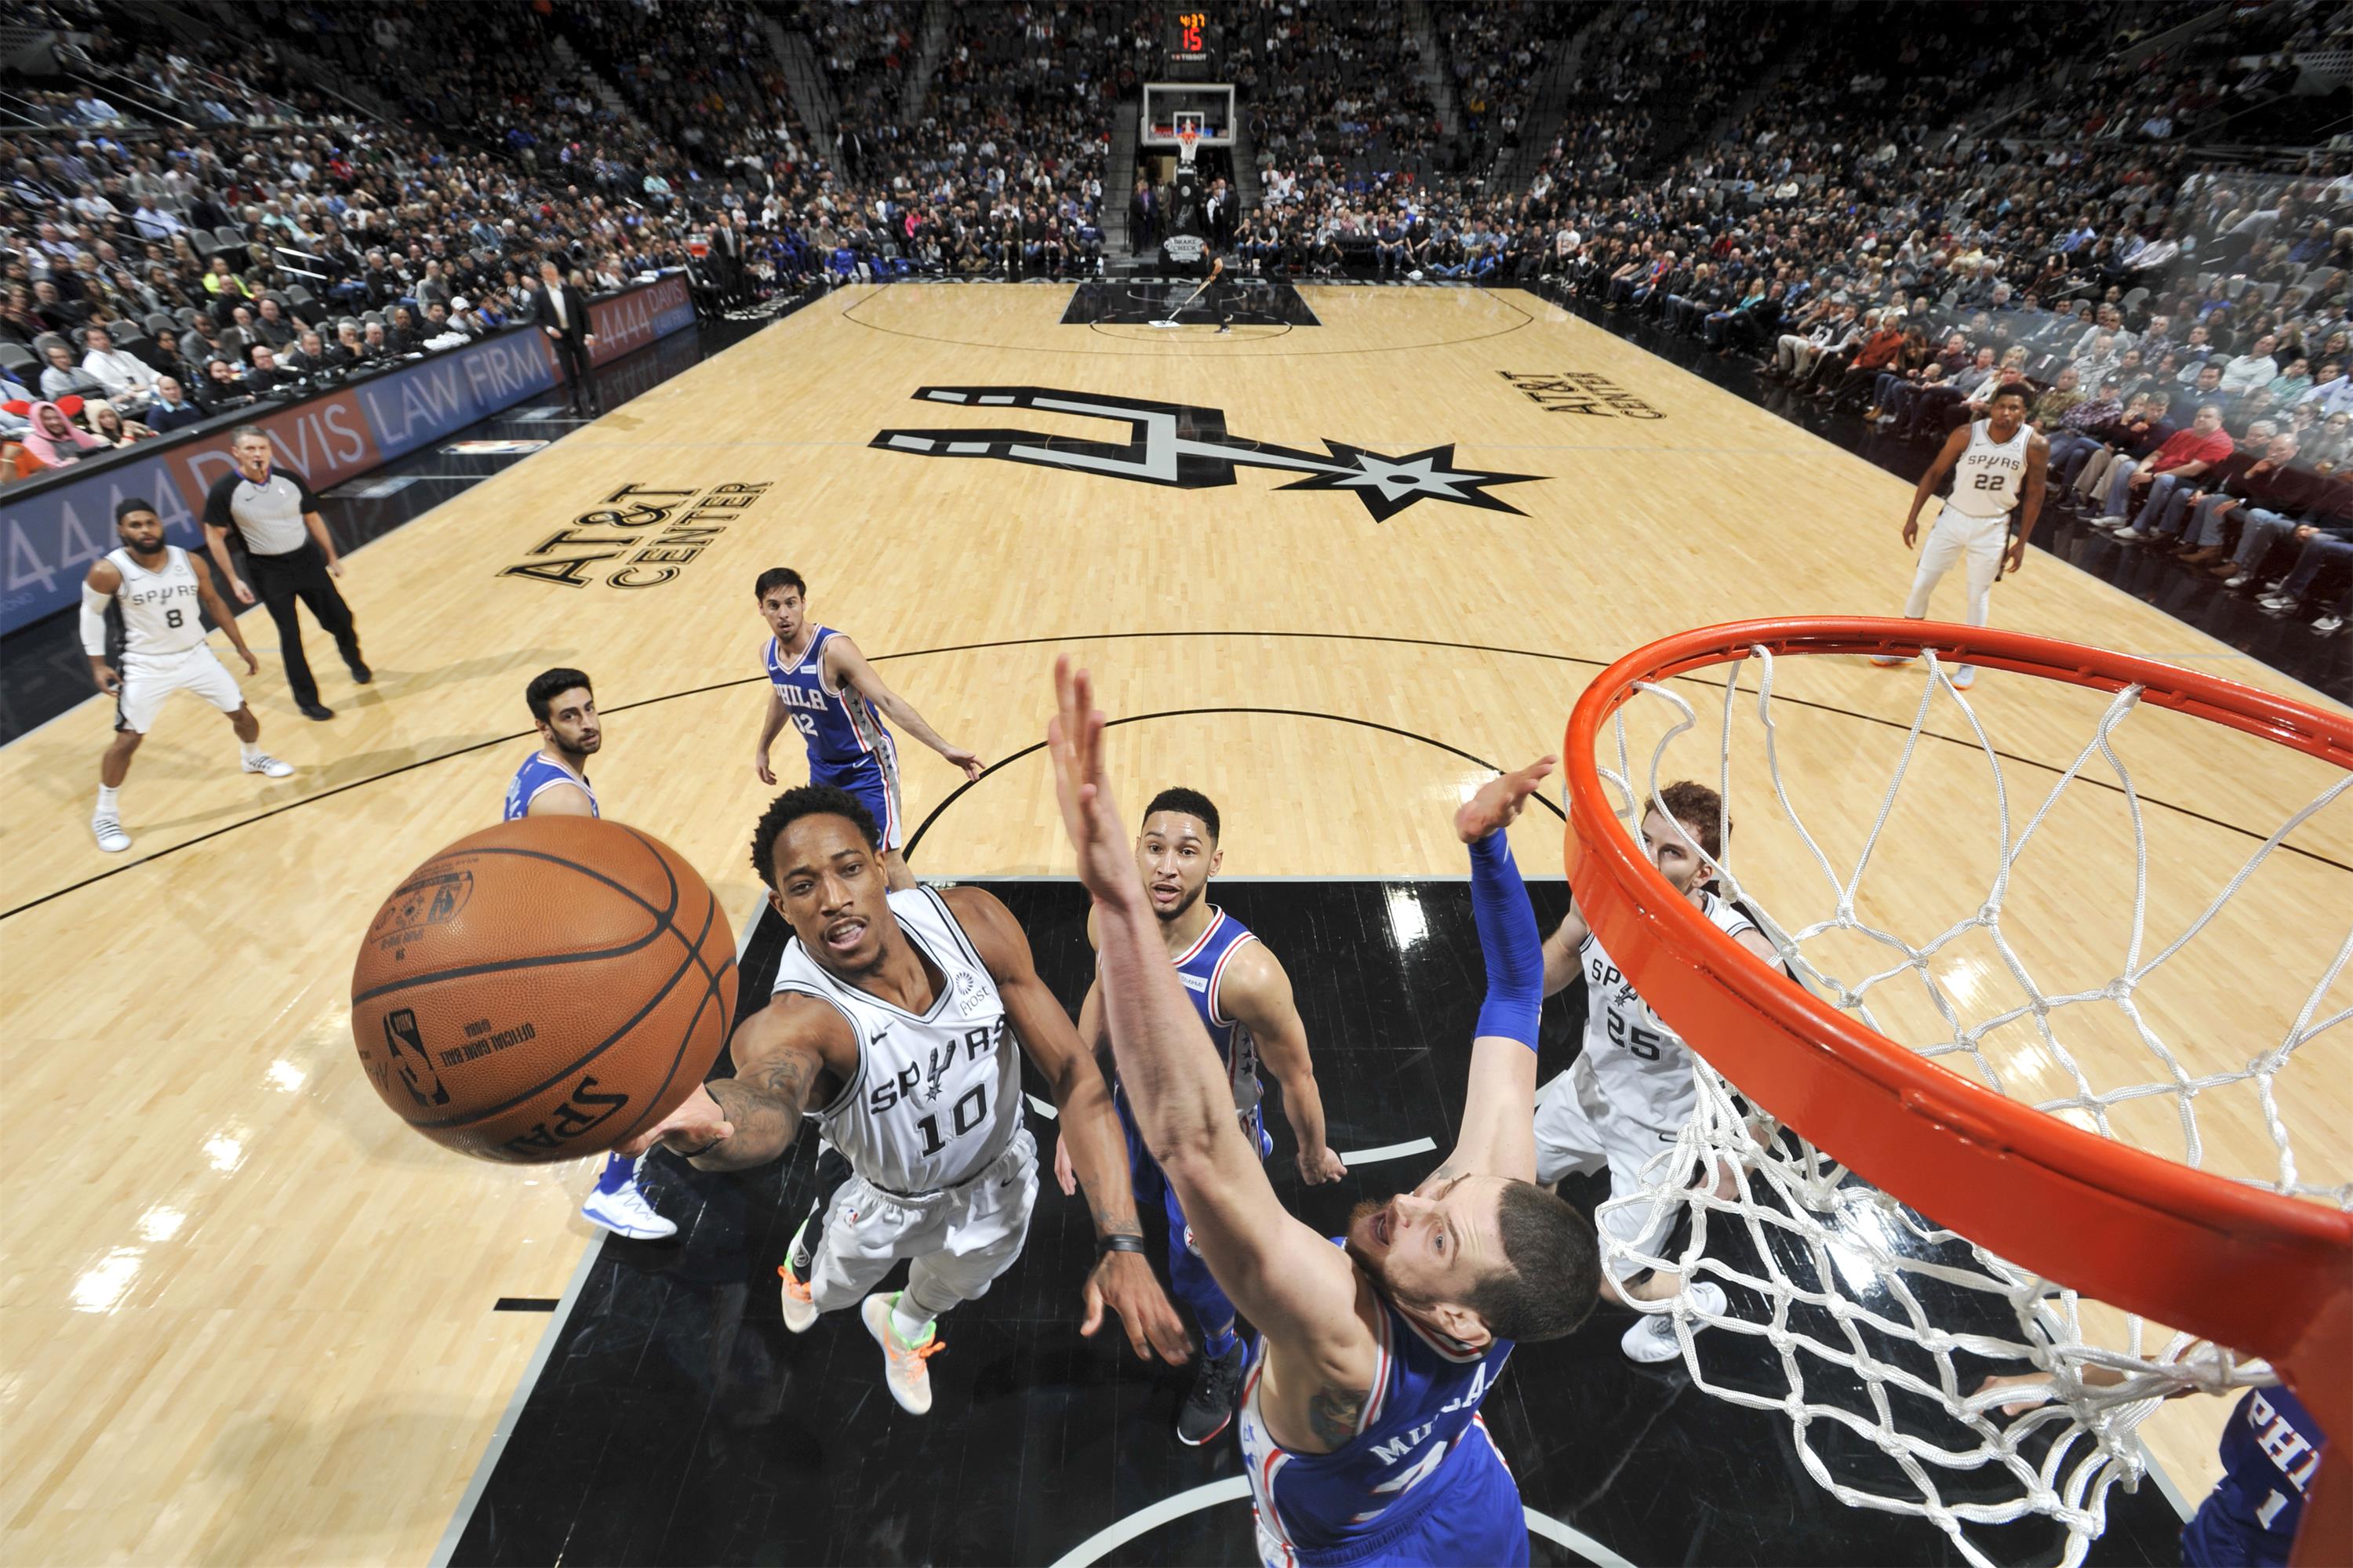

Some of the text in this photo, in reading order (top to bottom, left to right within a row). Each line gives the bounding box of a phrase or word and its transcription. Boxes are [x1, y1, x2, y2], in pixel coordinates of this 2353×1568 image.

[1184, 27, 1202, 51] 15
[646, 278, 683, 313] DAVIS
[367, 337, 547, 446] LAW FIRM
[1495, 370, 1620, 418] AT&T
[187, 403, 364, 499] DVIS
[1968, 455, 2020, 471] SPURS
[1974, 474, 2005, 491] 22
[495, 482, 702, 589] AT&T
[606, 481, 774, 590] CENTER
[132, 584, 198, 606] SPURS
[165, 609, 184, 628] 8
[393, 1013, 413, 1033] NBA
[959, 985, 991, 1017] Frost
[439, 1023, 536, 1068] OFFICIAL GAME BALL
[1607, 1006, 1661, 1061] 25
[915, 1082, 987, 1159] 10
[2246, 1388, 2321, 1502] PHI
[2255, 1487, 2289, 1530] 1
